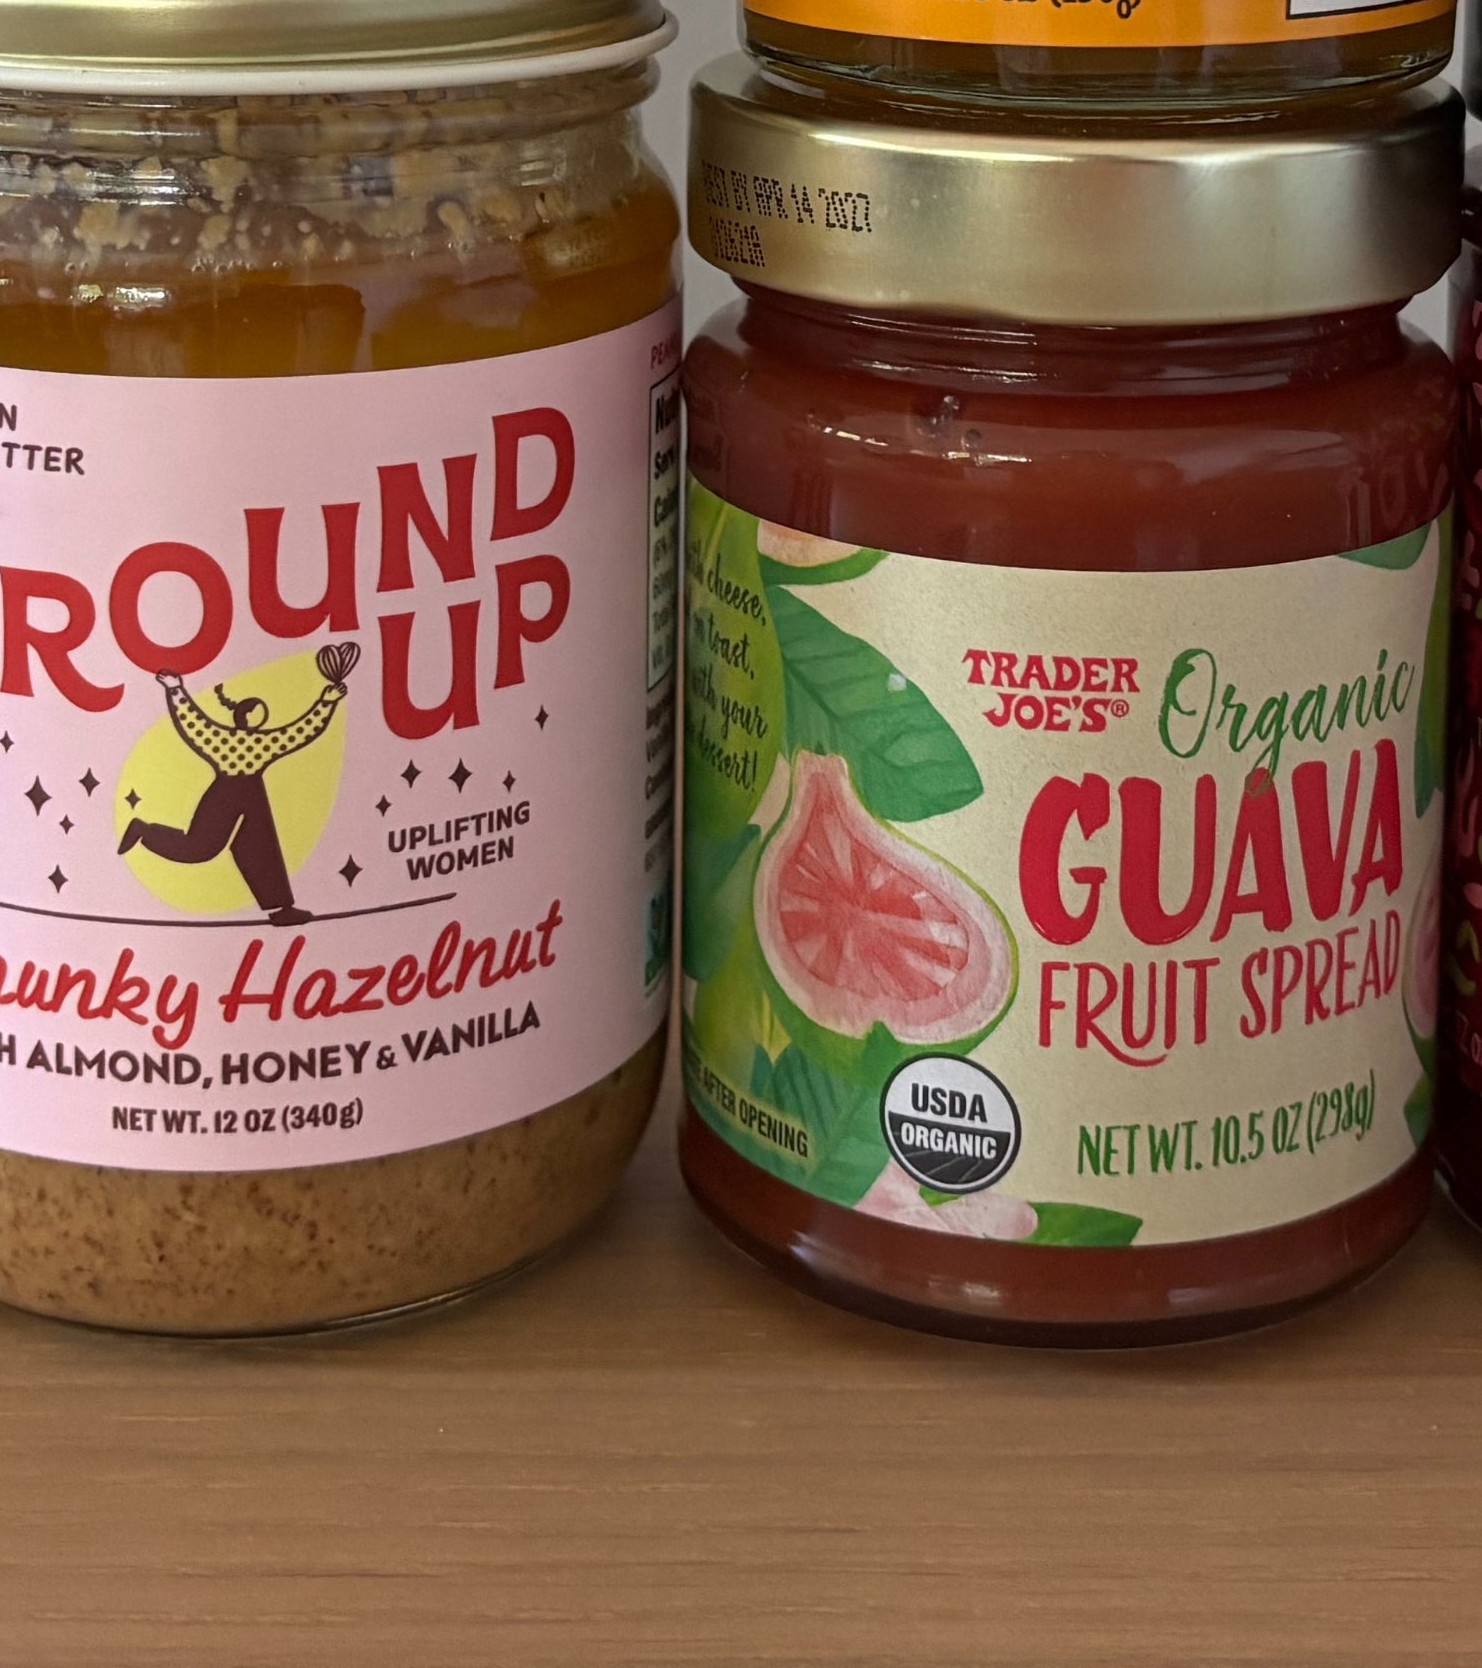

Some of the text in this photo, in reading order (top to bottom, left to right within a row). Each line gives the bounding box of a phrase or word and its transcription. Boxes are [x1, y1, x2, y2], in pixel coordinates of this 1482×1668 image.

[377, 554, 570, 740] UP
[961, 648, 1141, 693] TRADER
[1158, 648, 1414, 796] Organic
[388, 801, 531, 853] UPLIFTING
[406, 836, 515, 881] WOMEN
[1018, 737, 1403, 946] GUAVA
[218, 899, 563, 1023] Hazelnut
[1038, 909, 1401, 1067] FRUIT SPREAD
[26, 1039, 214, 1089] ALMOND,
[220, 1040, 371, 1085] HONEY
[376, 1046, 398, 1071] &
[401, 1001, 540, 1062] VANILLA
[112, 1098, 364, 1134] NET WT. 12 OZ (340g)
[900, 1121, 997, 1161] ORGANIC
[910, 1082, 988, 1124] USDA
[1077, 1069, 1376, 1177] NET WT. 10.5 OZ (298g)
